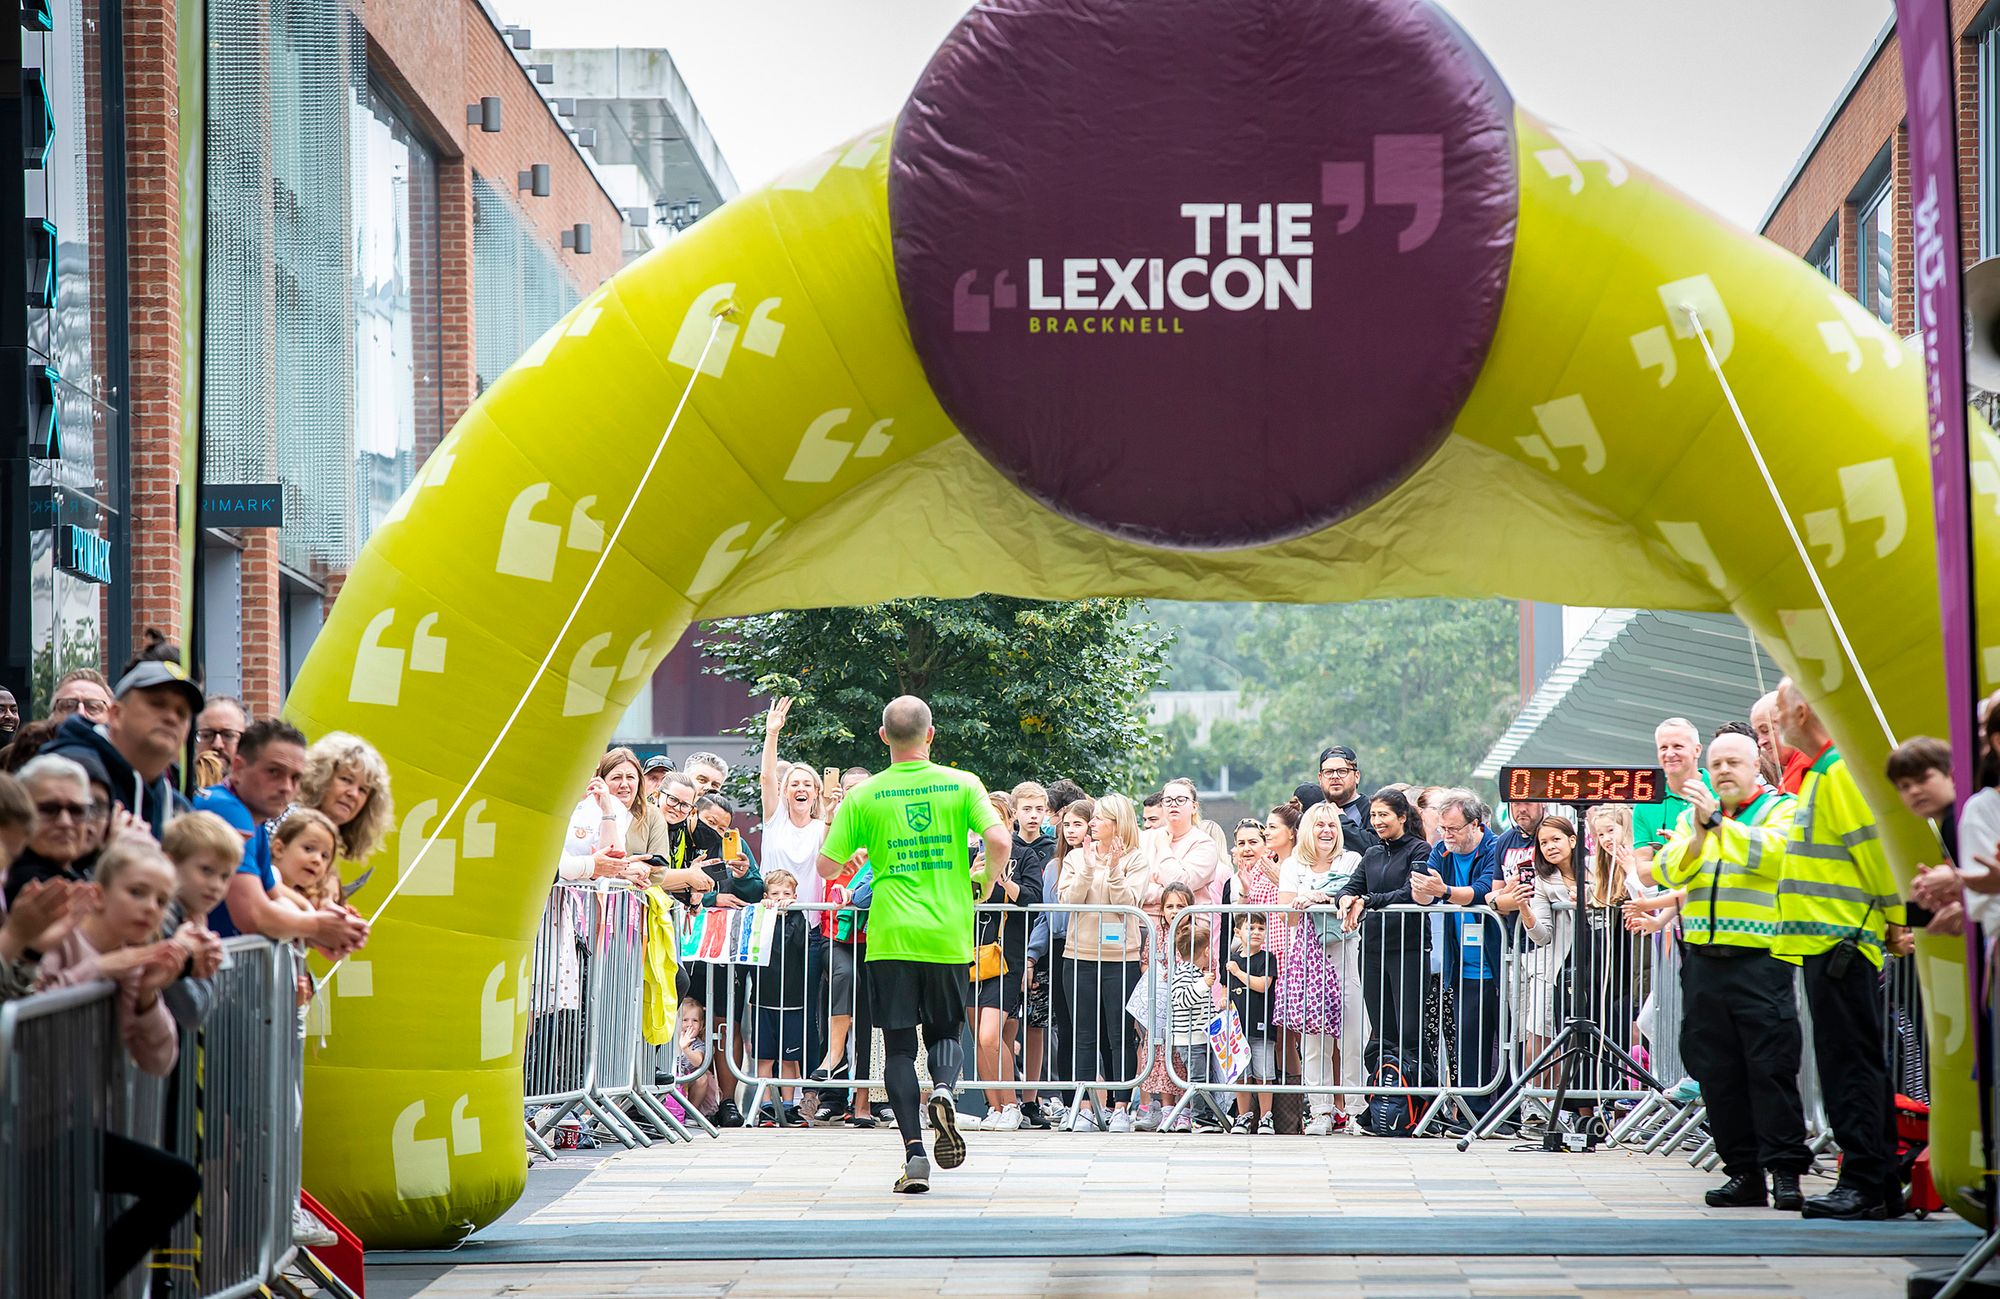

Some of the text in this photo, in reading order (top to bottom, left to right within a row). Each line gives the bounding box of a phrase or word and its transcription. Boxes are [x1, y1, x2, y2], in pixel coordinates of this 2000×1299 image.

[1180, 203, 1314, 256] THE
[1028, 257, 1313, 312] LEXICON
[1029, 316, 1185, 334] BRACKNELL
[203, 498, 273, 512] RIMARK
[72, 524, 112, 584] PRIMARK
[874, 783, 960, 800] #teamcrowthorne
[887, 834, 952, 849] School Running
[897, 848, 944, 860] to keep our
[889, 859, 953, 874] School Running
